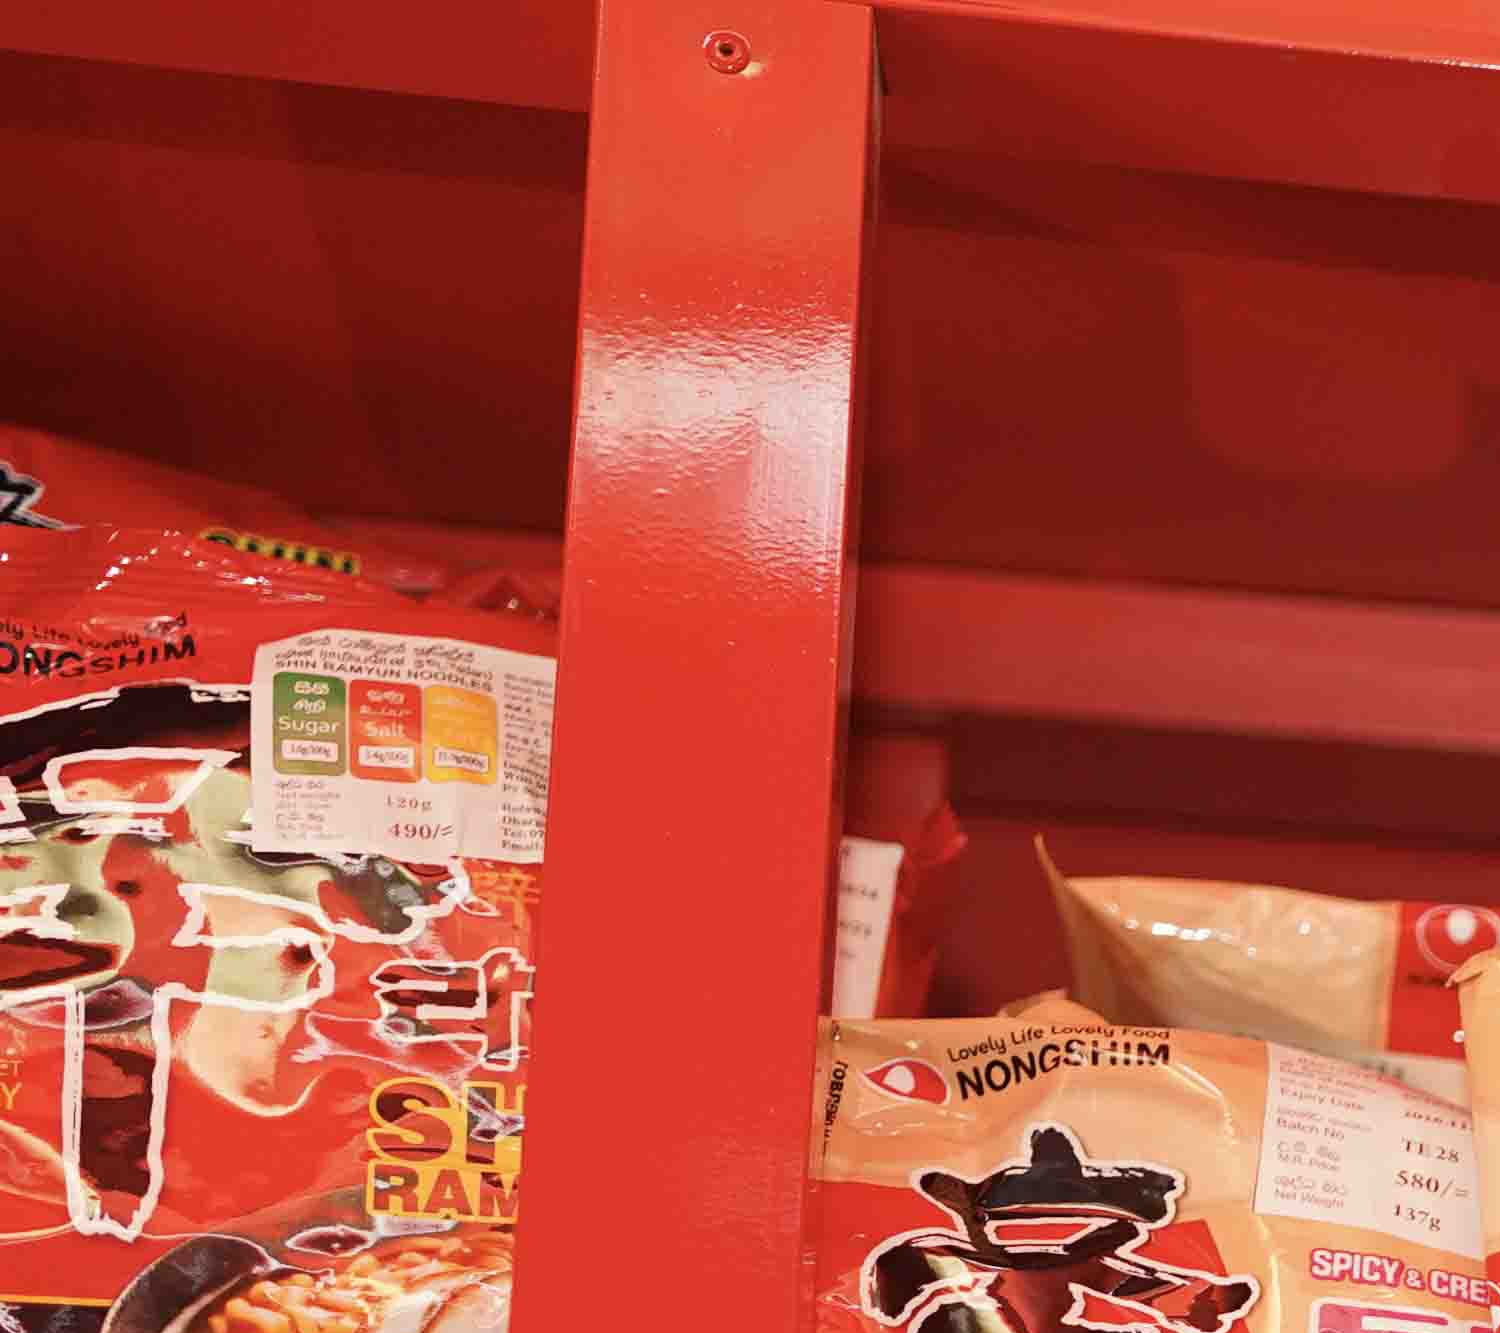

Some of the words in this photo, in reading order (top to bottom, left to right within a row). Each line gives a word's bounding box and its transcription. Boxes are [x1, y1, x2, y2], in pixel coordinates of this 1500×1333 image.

[279, 718, 340, 736] Sugar
[364, 722, 406, 737] Salt
[947, 1037, 1007, 1064] Lovely
[1010, 1027, 1044, 1047] Life
[957, 1040, 1171, 1101] NONGSHIM
[368, 1076, 527, 1166] SH
[366, 1162, 522, 1221] RAM
[1310, 1247, 1399, 1286] SPICY
